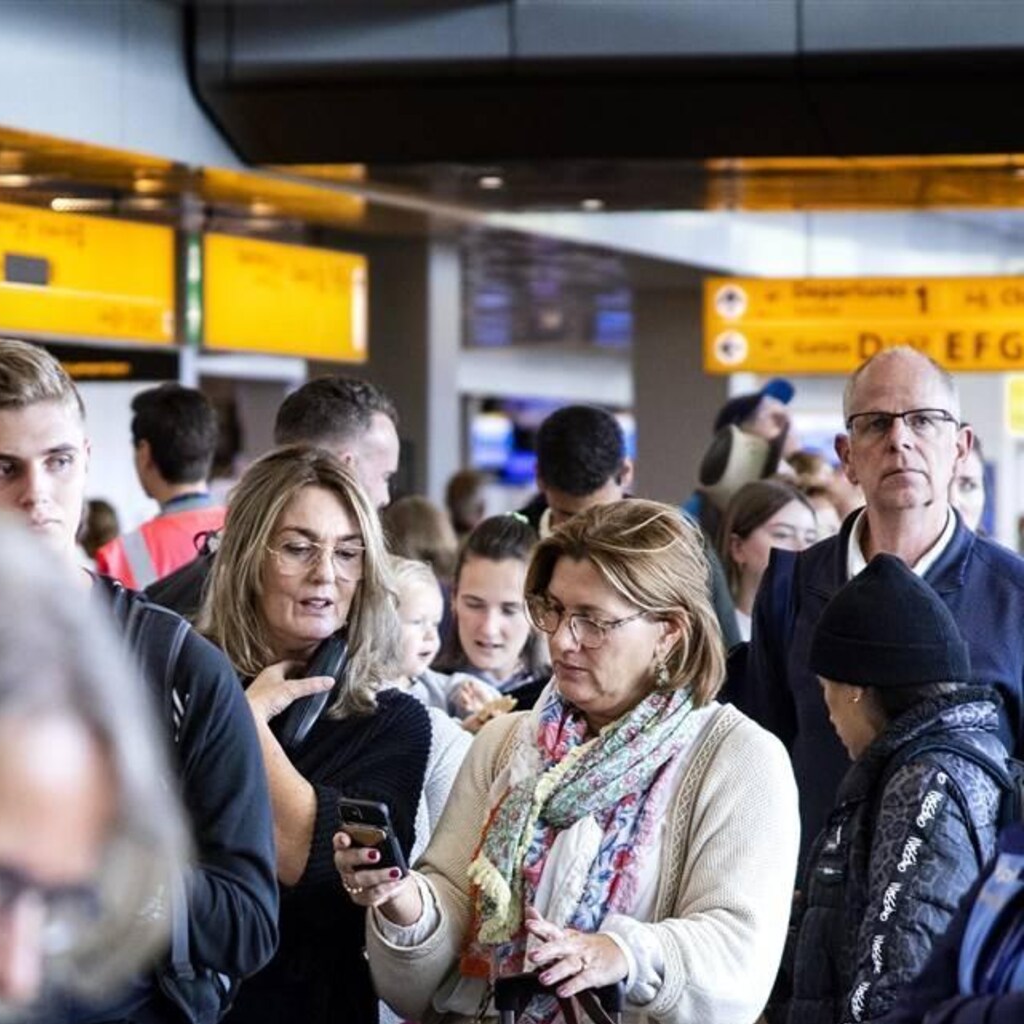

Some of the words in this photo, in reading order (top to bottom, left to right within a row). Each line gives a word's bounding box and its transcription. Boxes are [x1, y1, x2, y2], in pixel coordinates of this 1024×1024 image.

[916, 284, 930, 316] 1
[858, 332, 884, 361] D
[947, 331, 964, 361] E
[974, 331, 989, 360] F
[999, 331, 1023, 361] G
